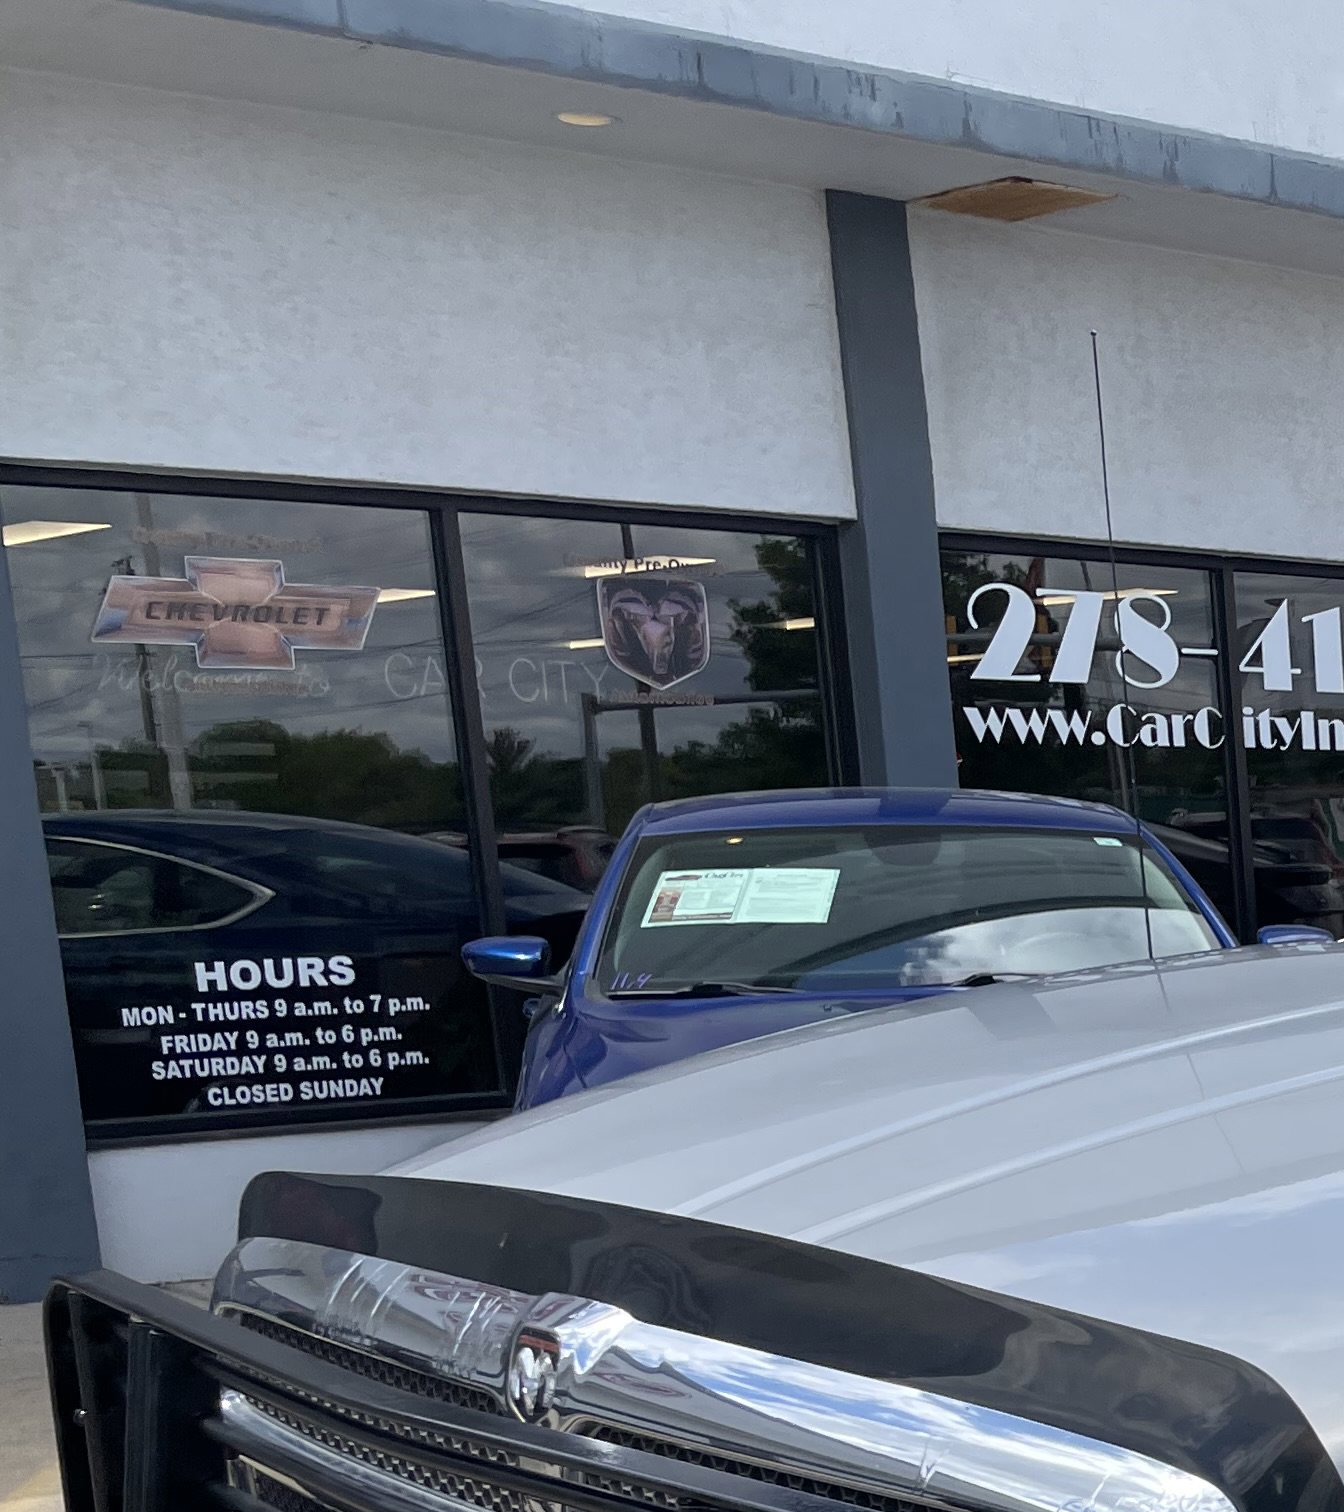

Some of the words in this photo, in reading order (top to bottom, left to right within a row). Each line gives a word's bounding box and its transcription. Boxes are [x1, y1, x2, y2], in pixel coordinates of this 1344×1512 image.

[145, 600, 330, 626] CHEVROLET
[508, 657, 609, 702] CITY
[194, 955, 355, 991] HOURS
[121, 1006, 174, 1026] MON
[191, 999, 269, 1022] THURS
[274, 999, 288, 1017] 9
[294, 1000, 338, 1017] a.m.
[343, 997, 365, 1014] to
[369, 994, 382, 1013] 7
[388, 996, 430, 1017] p.m.
[160, 1031, 239, 1055] FRIDAY
[246, 1030, 259, 1049] 9
[265, 1031, 310, 1047] a.m.
[315, 1027, 337, 1045] to
[342, 1024, 354, 1043] 6
[360, 1026, 402, 1046] p.m.
[151, 1055, 267, 1080] SATURDAY
[274, 1054, 287, 1073] 9
[293, 1055, 337, 1072] a.m.
[342, 1051, 363, 1068] to
[369, 1049, 382, 1068] 6
[387, 1050, 430, 1071] p.m.
[207, 1083, 294, 1107] CLOSED
[300, 1077, 384, 1100] SUNDAY
